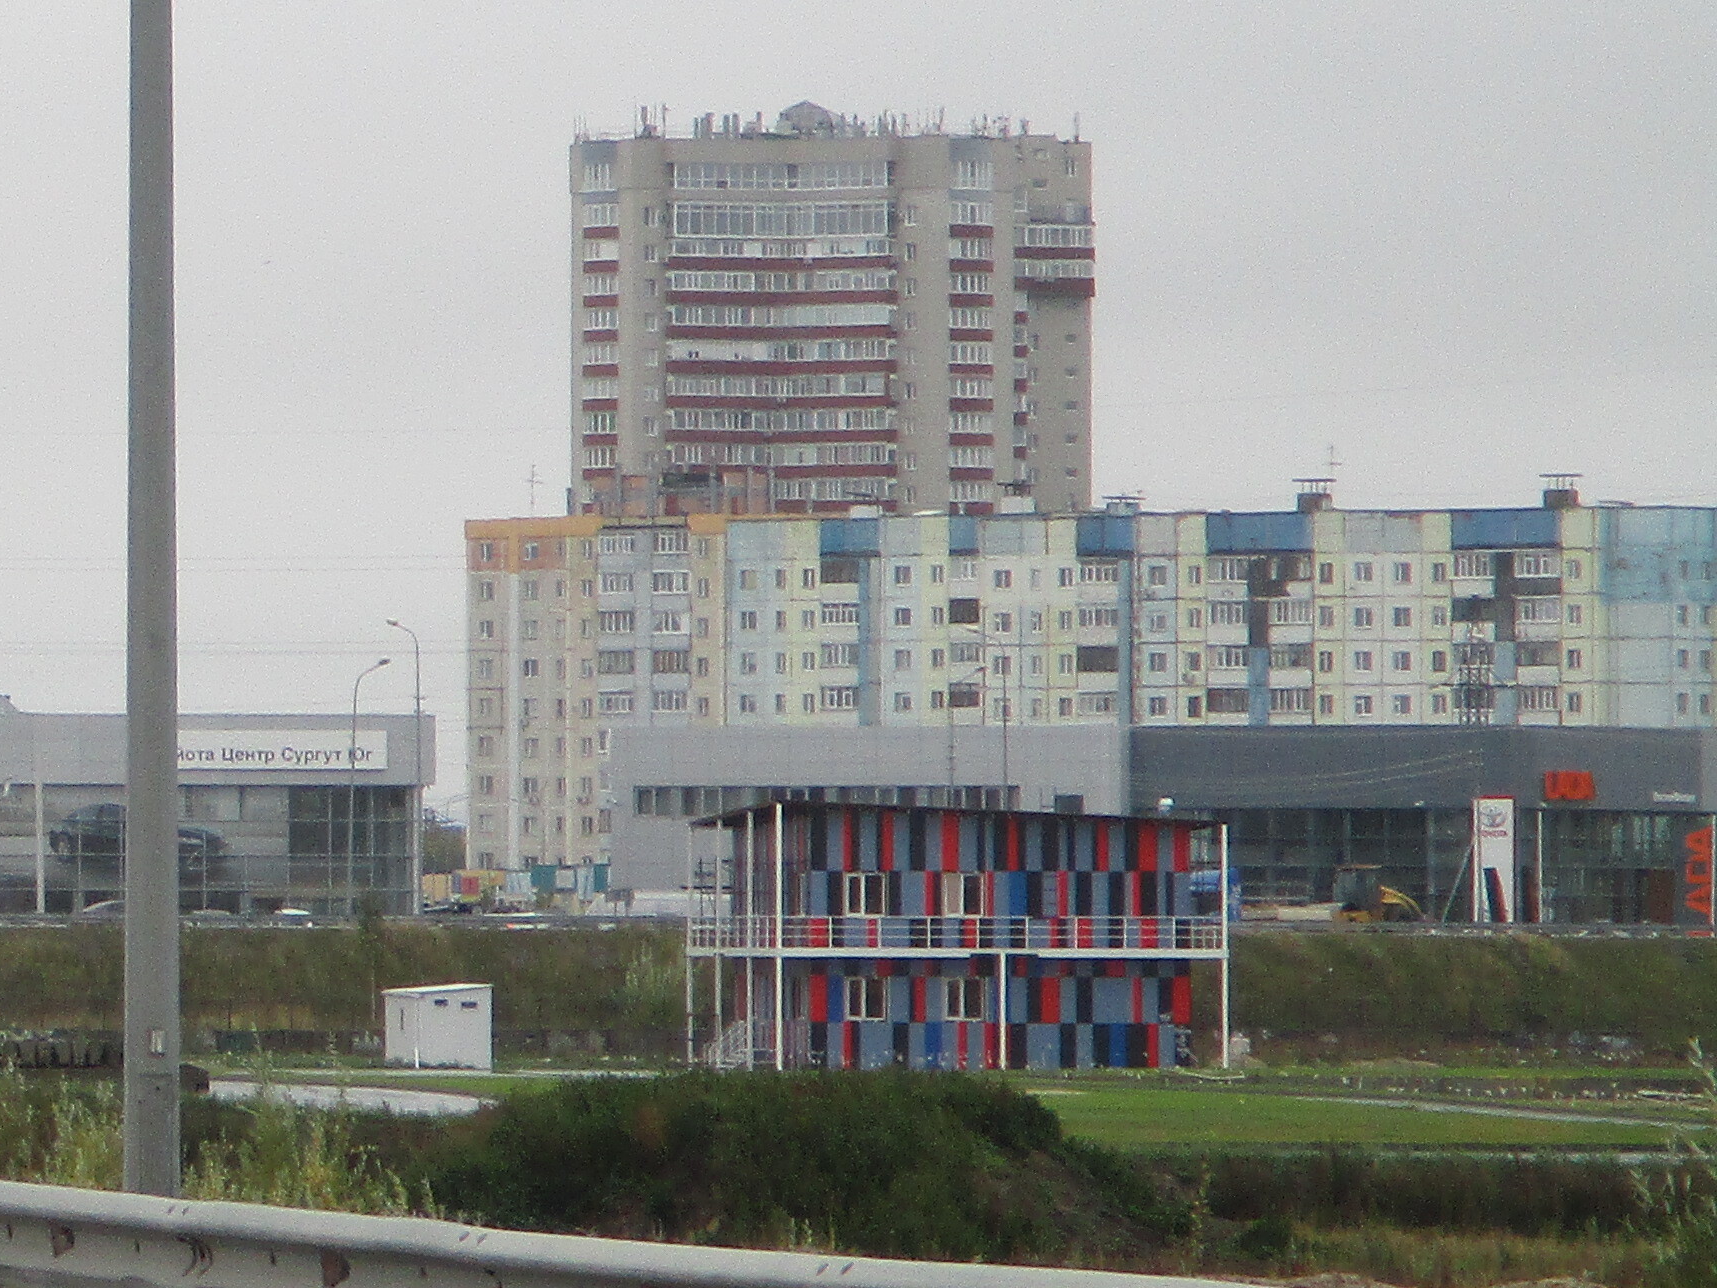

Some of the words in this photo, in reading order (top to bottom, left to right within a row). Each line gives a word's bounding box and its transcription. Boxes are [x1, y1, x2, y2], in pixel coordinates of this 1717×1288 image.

[177, 746, 215, 763] йота
[221, 747, 275, 765] Центр
[281, 747, 342, 765] Сургут
[348, 747, 373, 762] Юг
